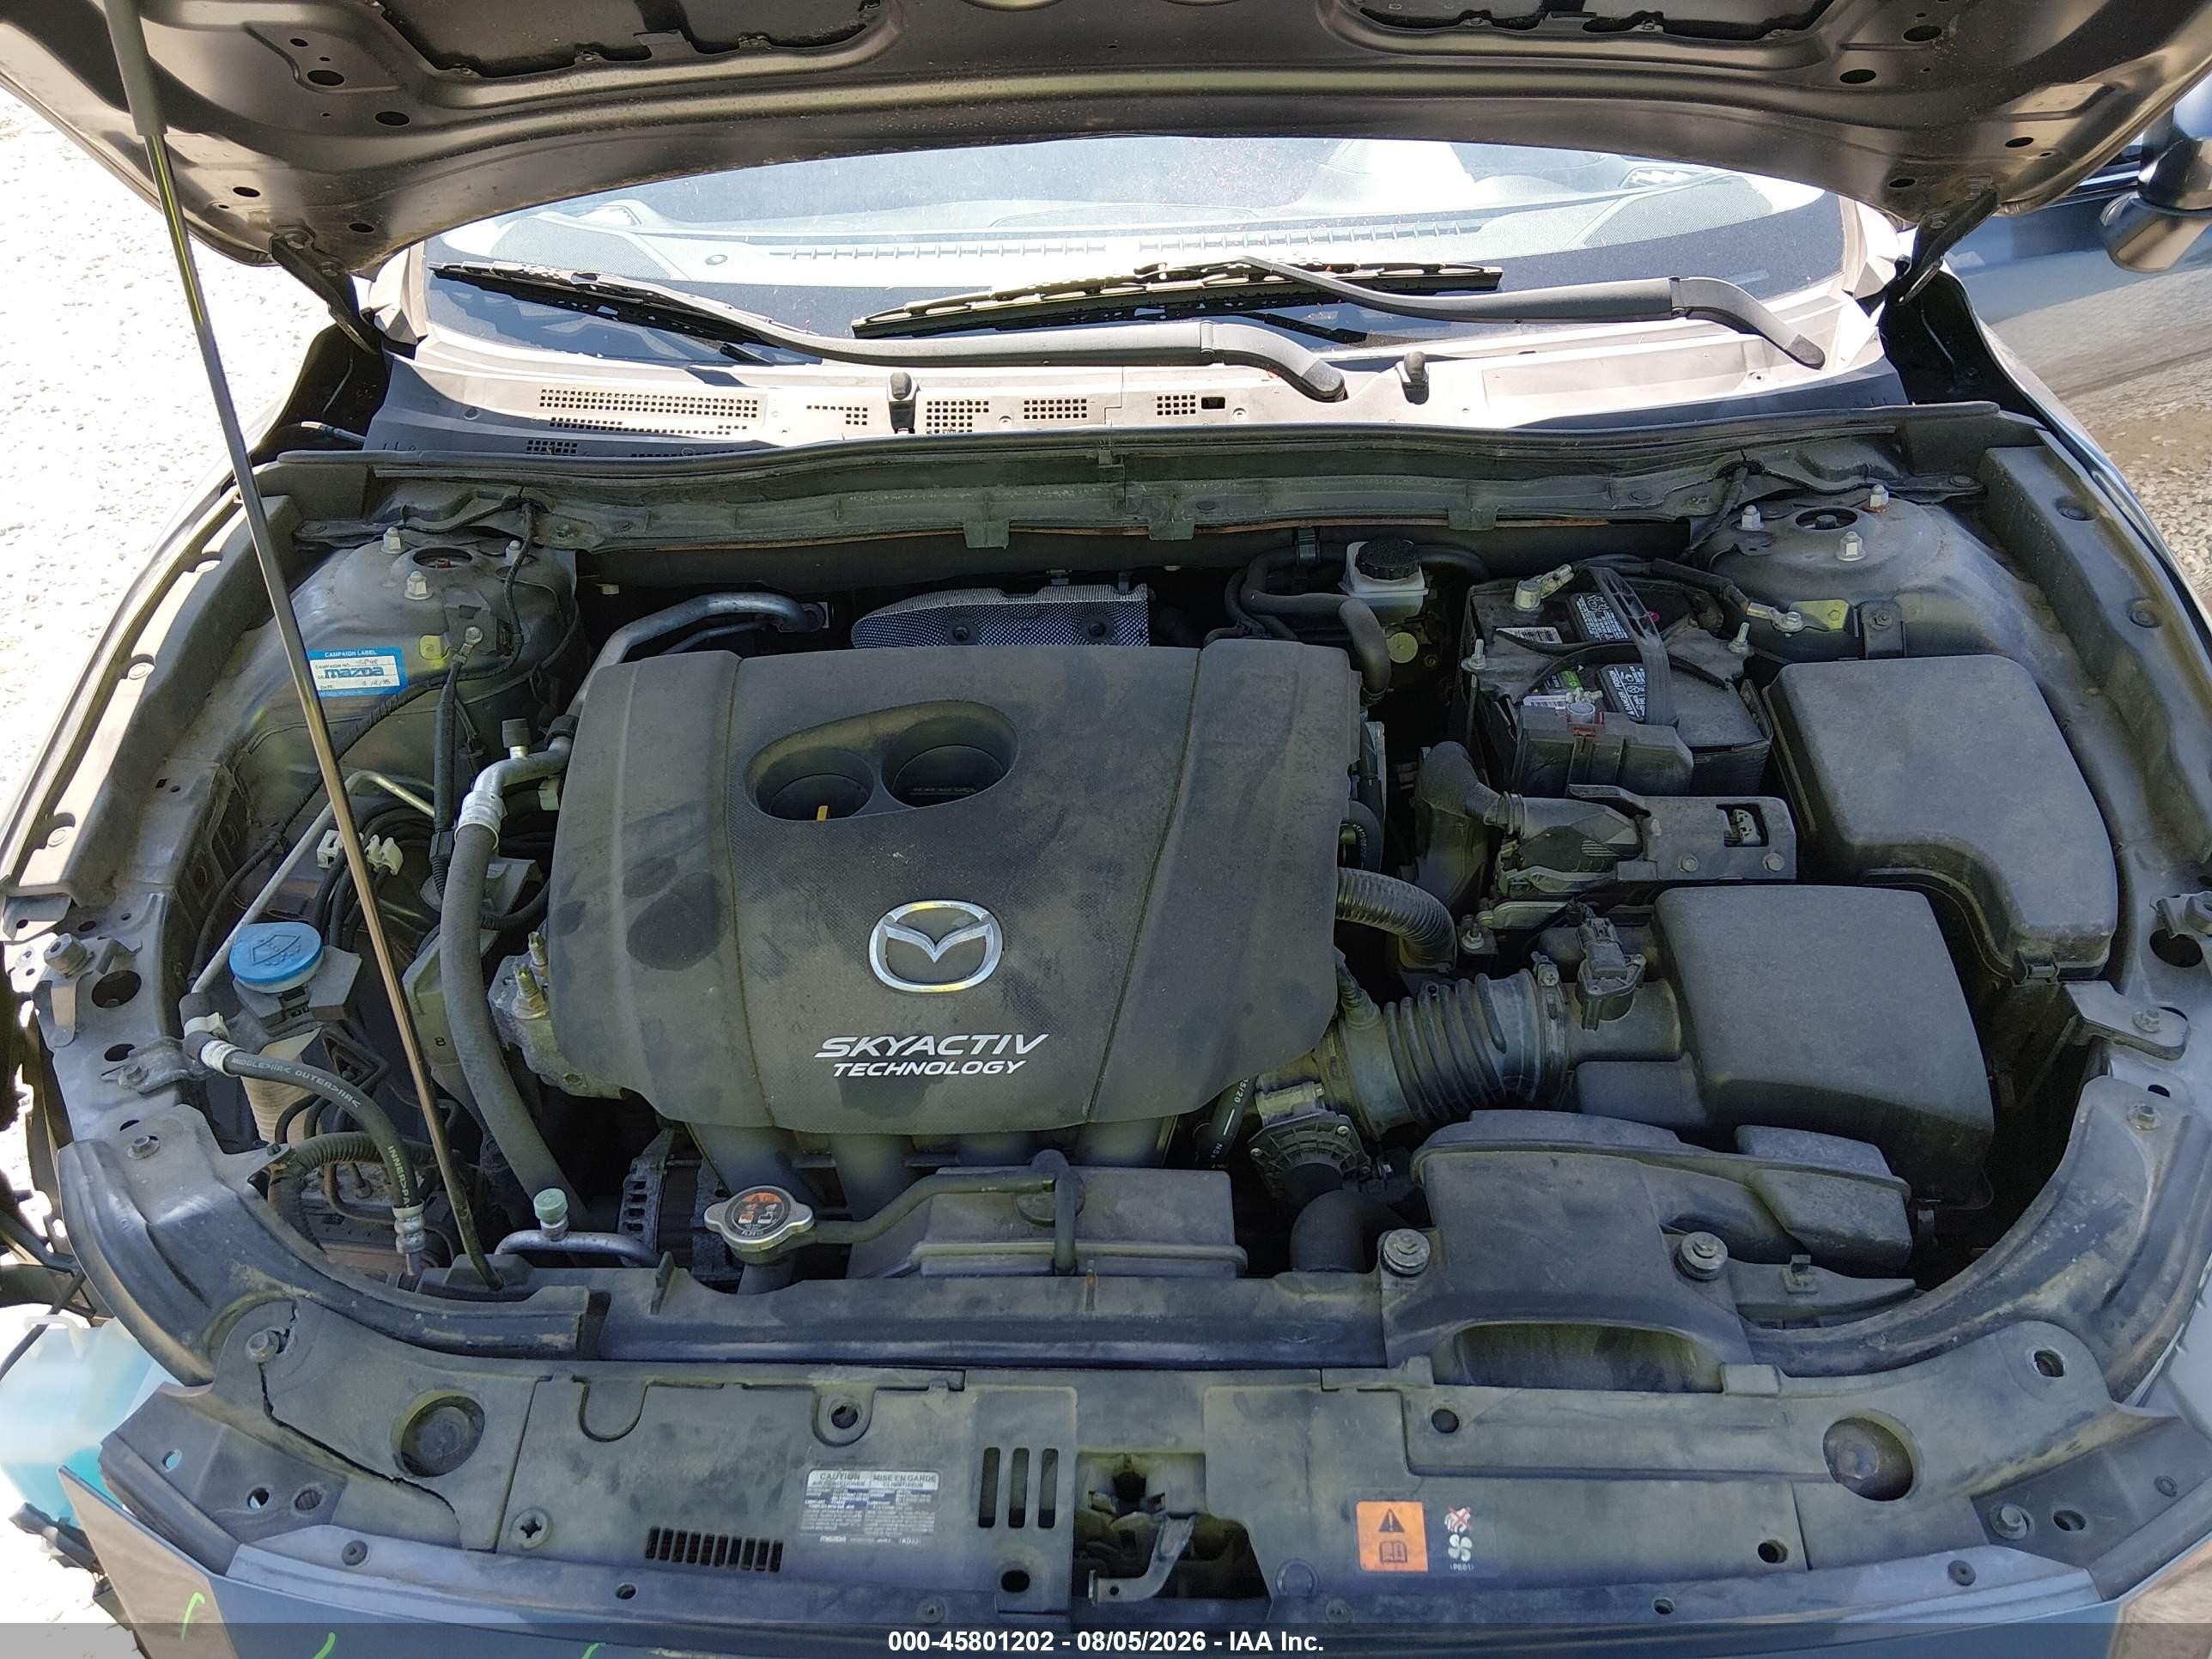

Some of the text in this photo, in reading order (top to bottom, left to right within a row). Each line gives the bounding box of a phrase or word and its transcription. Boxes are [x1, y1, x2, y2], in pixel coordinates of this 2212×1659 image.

[324, 665, 385, 679] mazda
[815, 1034, 1049, 1058] SKYACTIV
[833, 1060, 1027, 1077] TECHNOLOGY
[387, 1146, 411, 1208] INNER>PA
